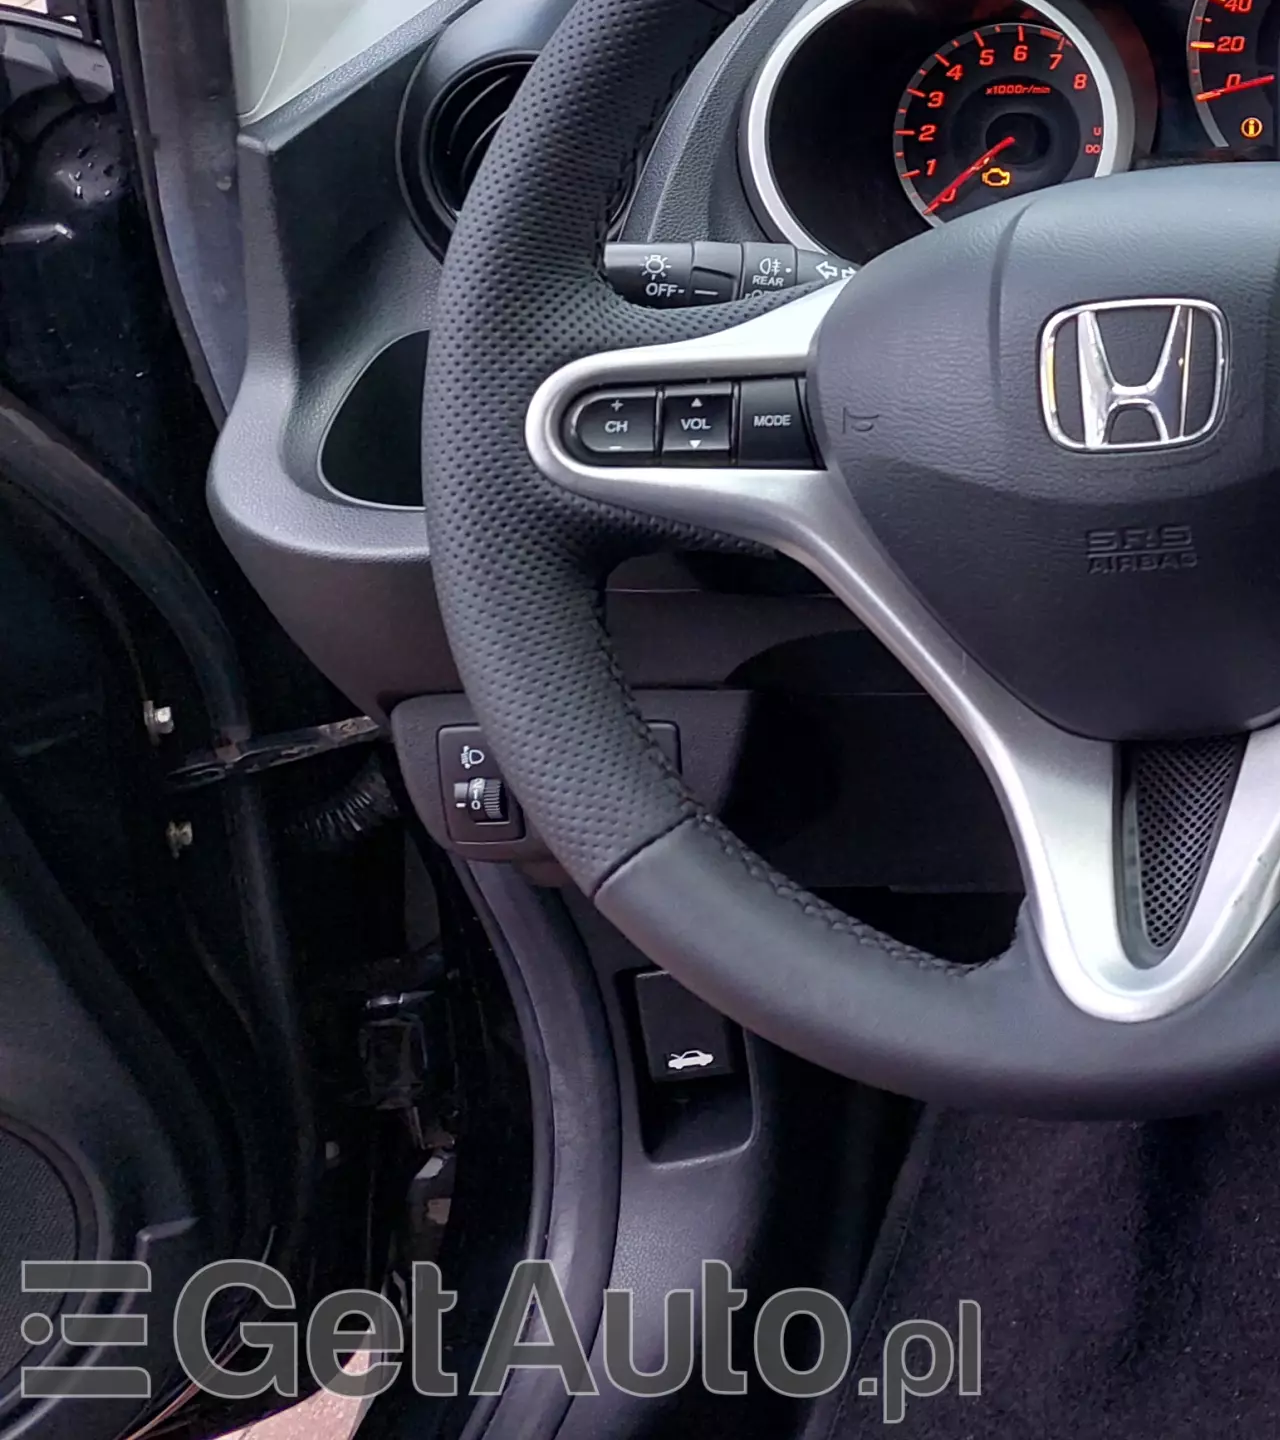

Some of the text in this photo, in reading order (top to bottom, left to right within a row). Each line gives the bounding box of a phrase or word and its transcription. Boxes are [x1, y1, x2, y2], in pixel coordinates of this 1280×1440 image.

[1216, 36, 1246, 53] 20
[979, 49, 995, 66] 5
[1013, 45, 1029, 62] 6
[1049, 54, 1063, 70] 7
[946, 64, 963, 81] 4
[1073, 73, 1088, 90] 8
[927, 91, 944, 108] 3
[918, 124, 937, 141] 2
[926, 159, 937, 176] 1
[646, 282, 678, 297] OFF
[752, 275, 784, 287] REAR
[604, 419, 628, 434] CH
[681, 417, 711, 431] VOL
[753, 414, 791, 428] MODE
